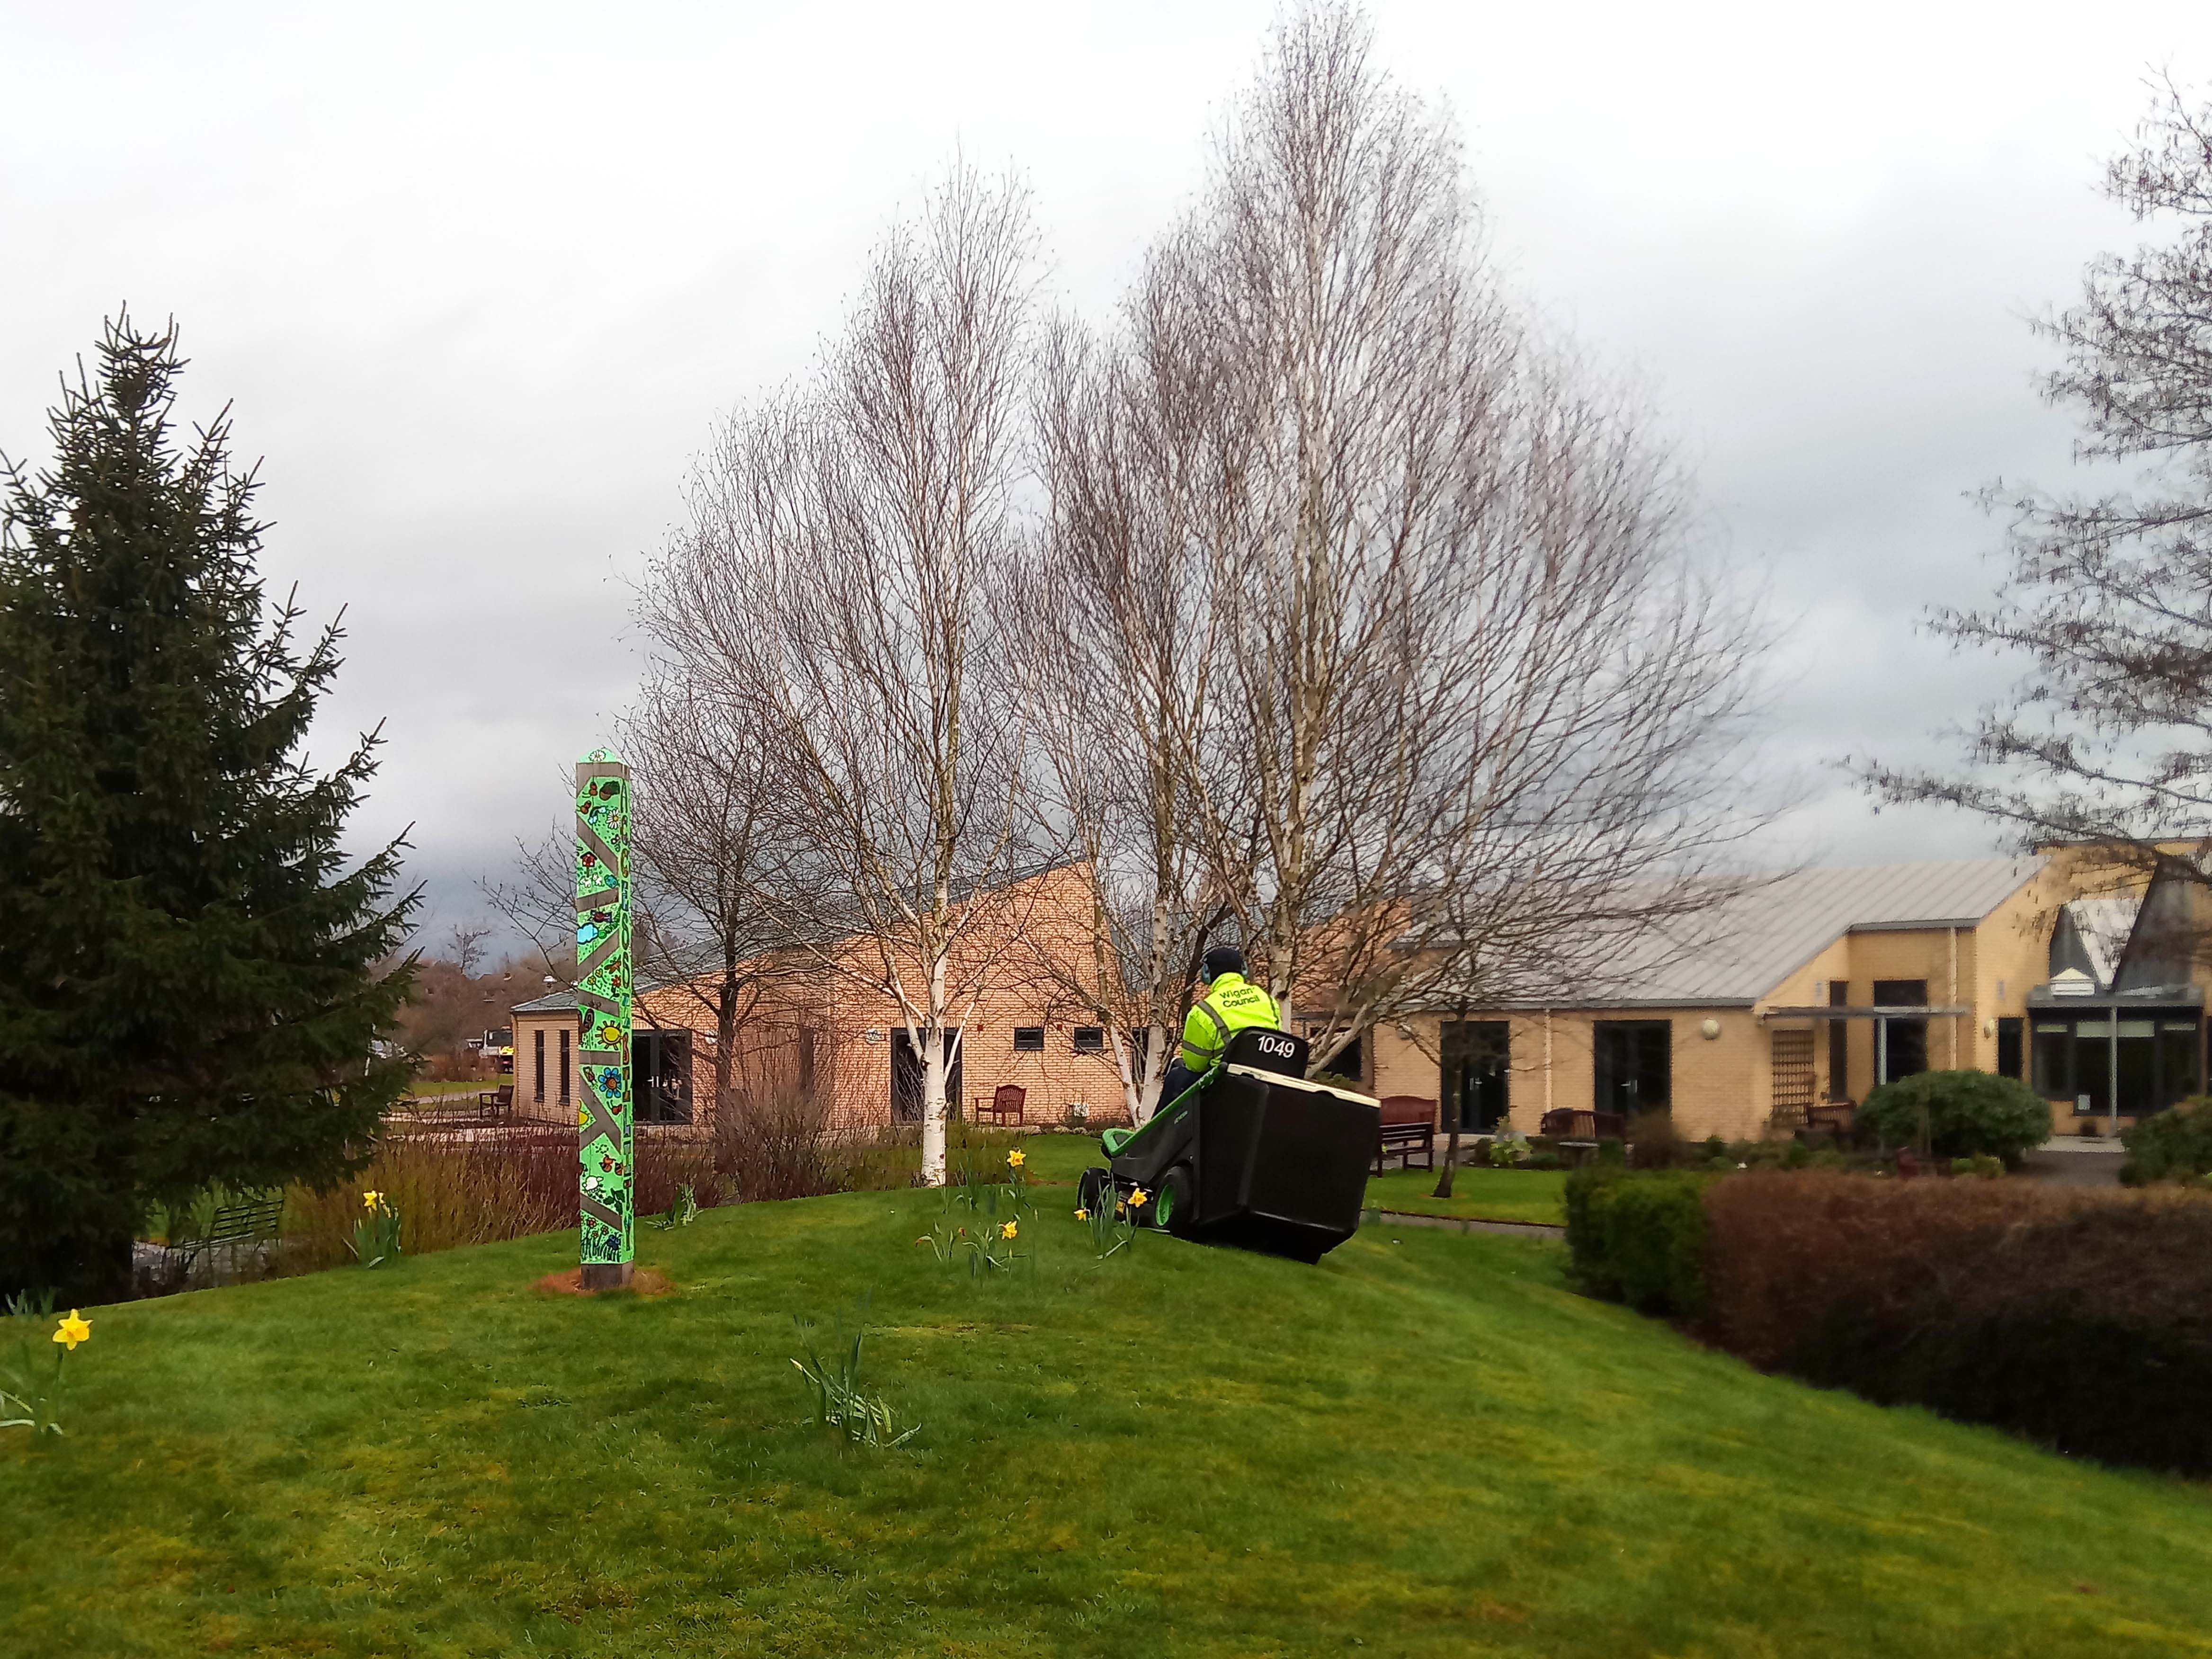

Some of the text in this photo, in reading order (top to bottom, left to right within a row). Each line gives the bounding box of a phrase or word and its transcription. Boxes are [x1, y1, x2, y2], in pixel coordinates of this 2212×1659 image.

[1220, 988, 1253, 999] Wigan
[1223, 995, 1260, 1008] Council
[1258, 1036, 1295, 1058] 1049
